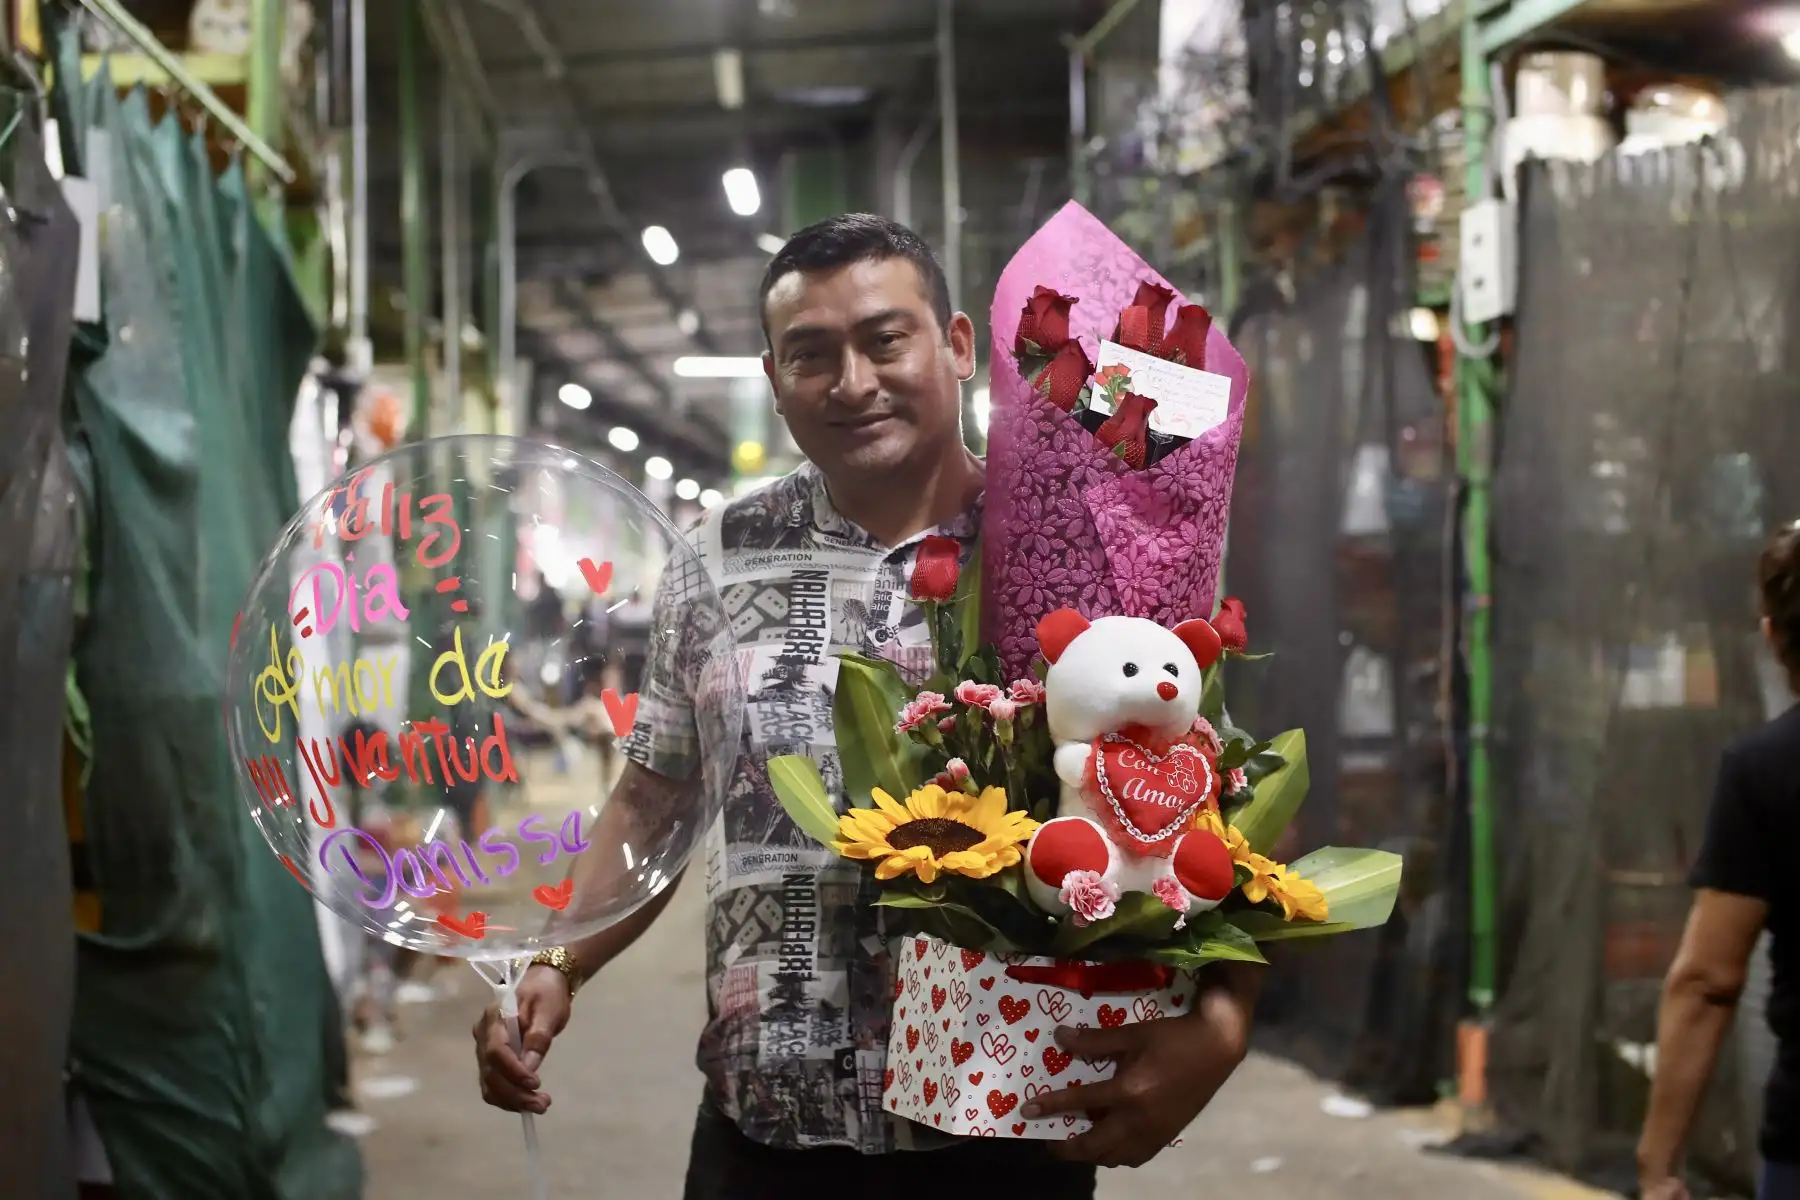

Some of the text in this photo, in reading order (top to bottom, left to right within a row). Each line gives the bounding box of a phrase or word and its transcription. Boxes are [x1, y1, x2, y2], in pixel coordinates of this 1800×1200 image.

[744, 553, 813, 567] GENERATION
[254, 622, 513, 743] Amor de
[296, 712, 519, 829] juventud
[1117, 748, 1161, 776] Con
[1122, 777, 1187, 813] Amor
[742, 853, 798, 867] GENERATION
